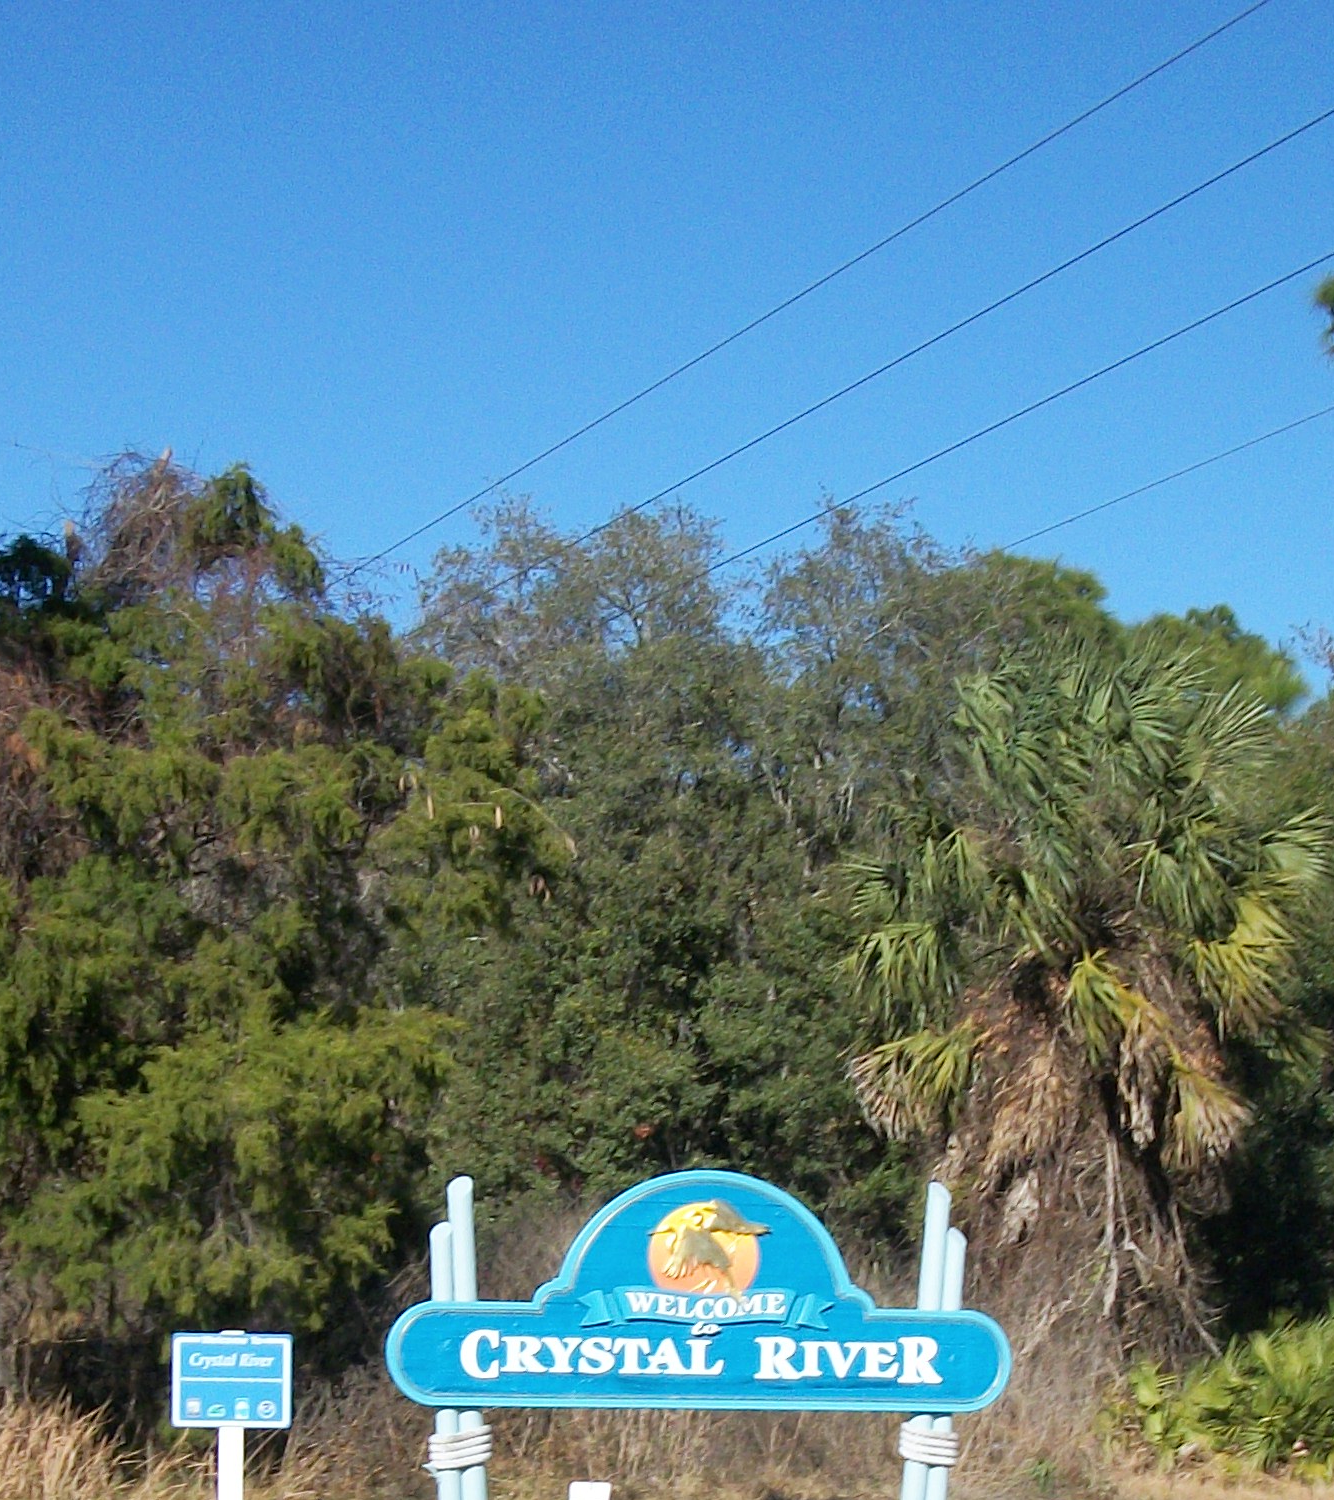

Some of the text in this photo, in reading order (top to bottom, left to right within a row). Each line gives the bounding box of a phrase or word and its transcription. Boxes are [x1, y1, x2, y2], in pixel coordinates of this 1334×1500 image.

[625, 1291, 786, 1319] WELCOME
[691, 1321, 722, 1336] to
[460, 1329, 943, 1384] CRYSTAL RIVER
